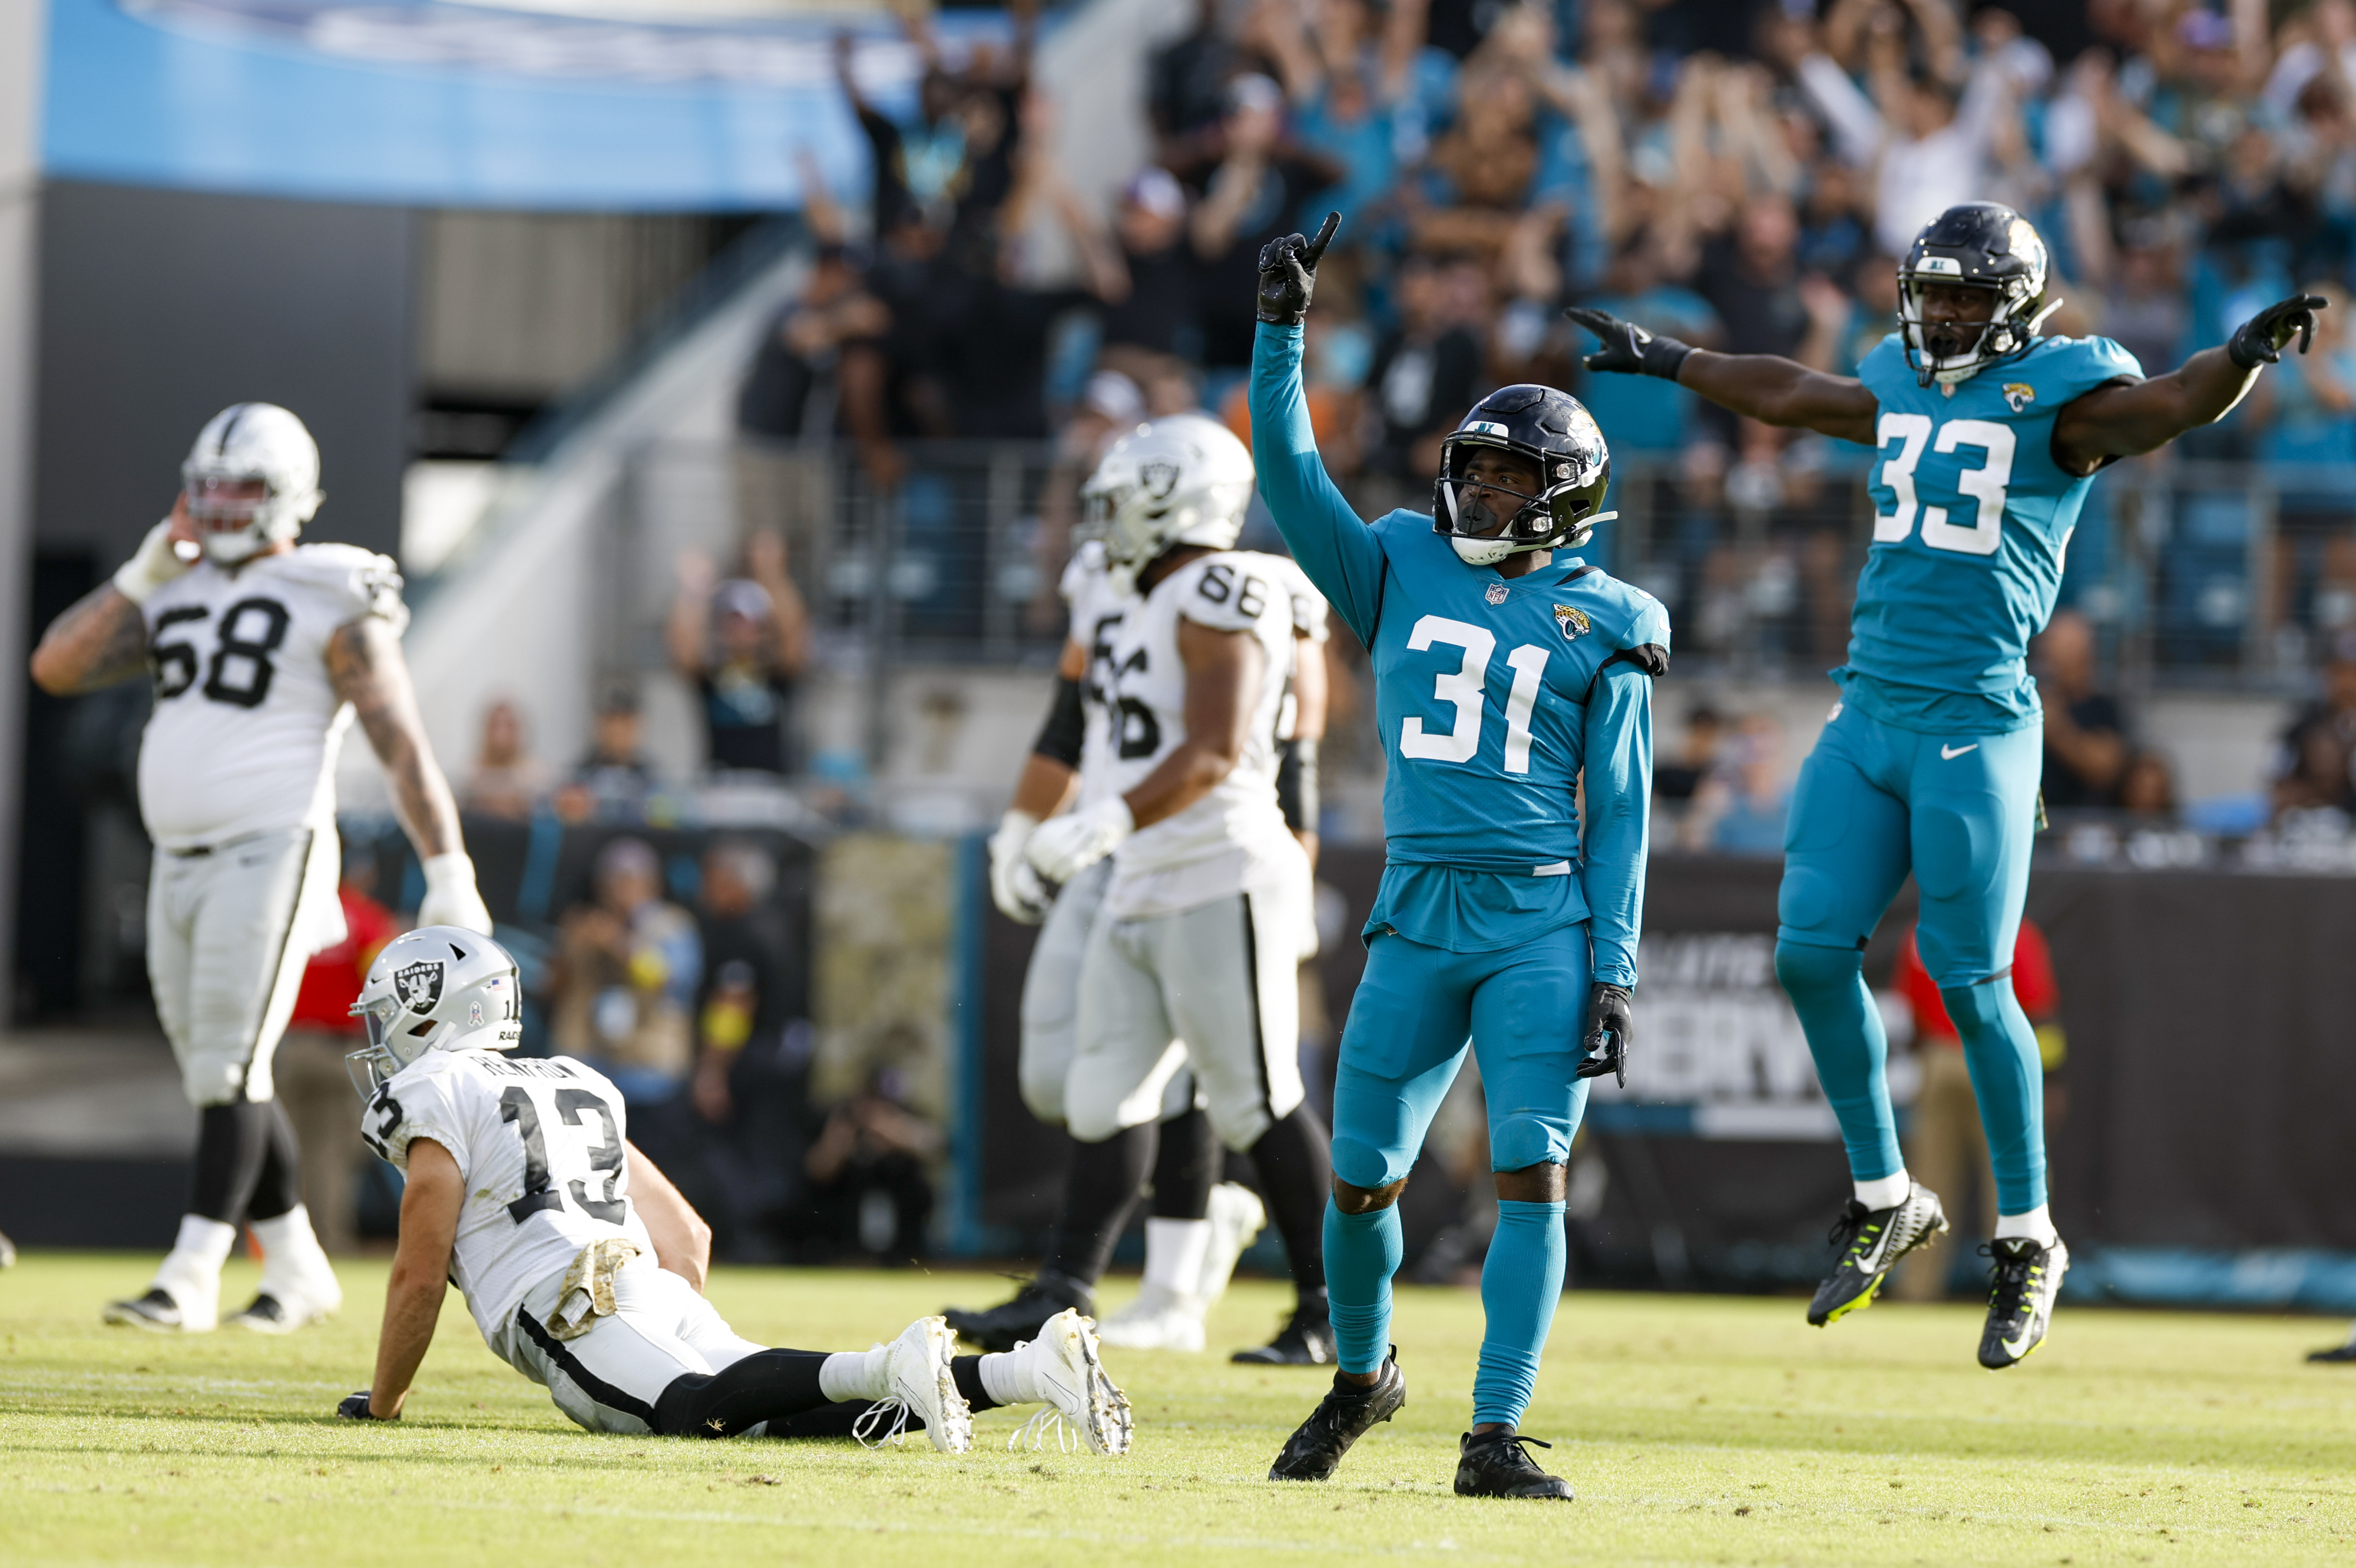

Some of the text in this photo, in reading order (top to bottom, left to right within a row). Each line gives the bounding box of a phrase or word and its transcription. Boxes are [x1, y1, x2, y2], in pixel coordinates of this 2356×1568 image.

[1874, 412, 2017, 555] 33
[1199, 564, 1269, 620] 66
[1488, 591, 1502, 601] NFL
[152, 597, 291, 709] 68
[1399, 614, 1551, 775] 31
[398, 962, 440, 978] RAIDERS
[499, 1086, 627, 1226] 13
